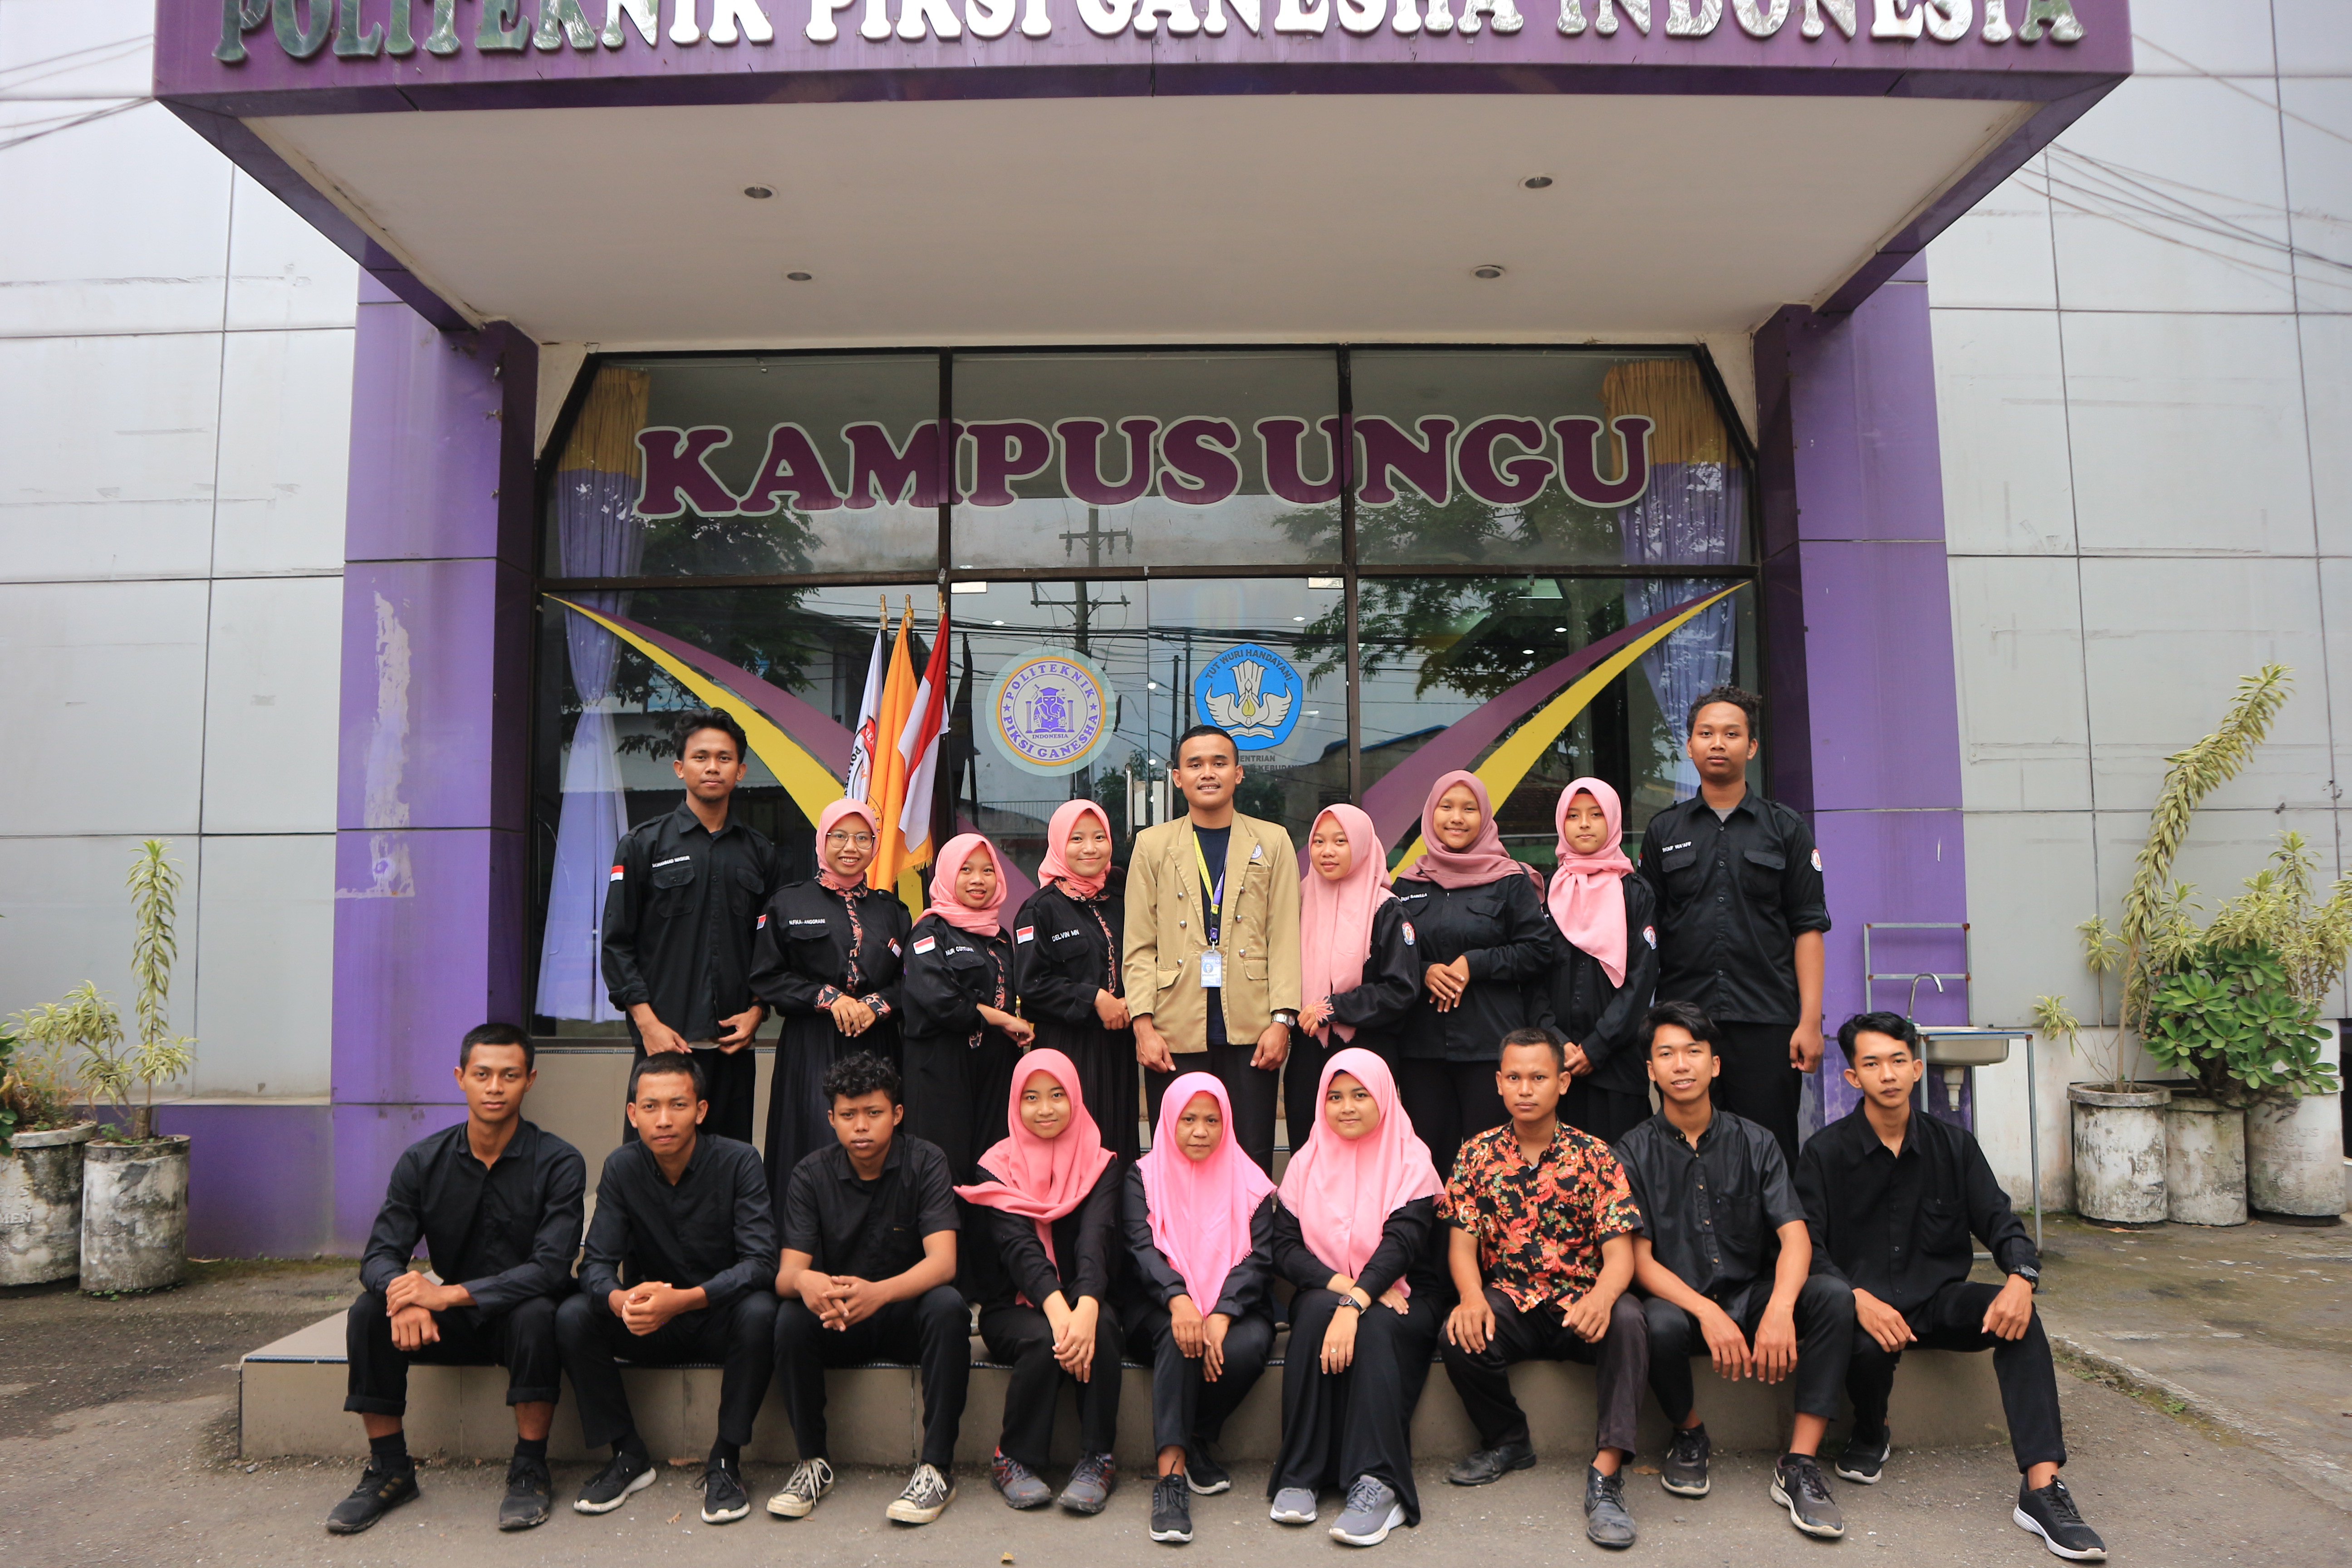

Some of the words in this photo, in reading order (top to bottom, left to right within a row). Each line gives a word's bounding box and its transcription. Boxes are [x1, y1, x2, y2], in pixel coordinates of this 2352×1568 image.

[635, 415, 1242, 517] KAMPUS
[1253, 415, 1655, 508] UNGU
[1205, 662, 1220, 679] TUT
[1220, 649, 1245, 664] WURI
[1245, 649, 1294, 681] HANDAYANI
[1006, 664, 1095, 701] POLITEKNIK
[1003, 715, 1034, 754] PIKSI
[1037, 714, 1098, 758] GANESHA
[945, 947, 956, 956] NUR
[1052, 931, 1070, 942] DELVIN
